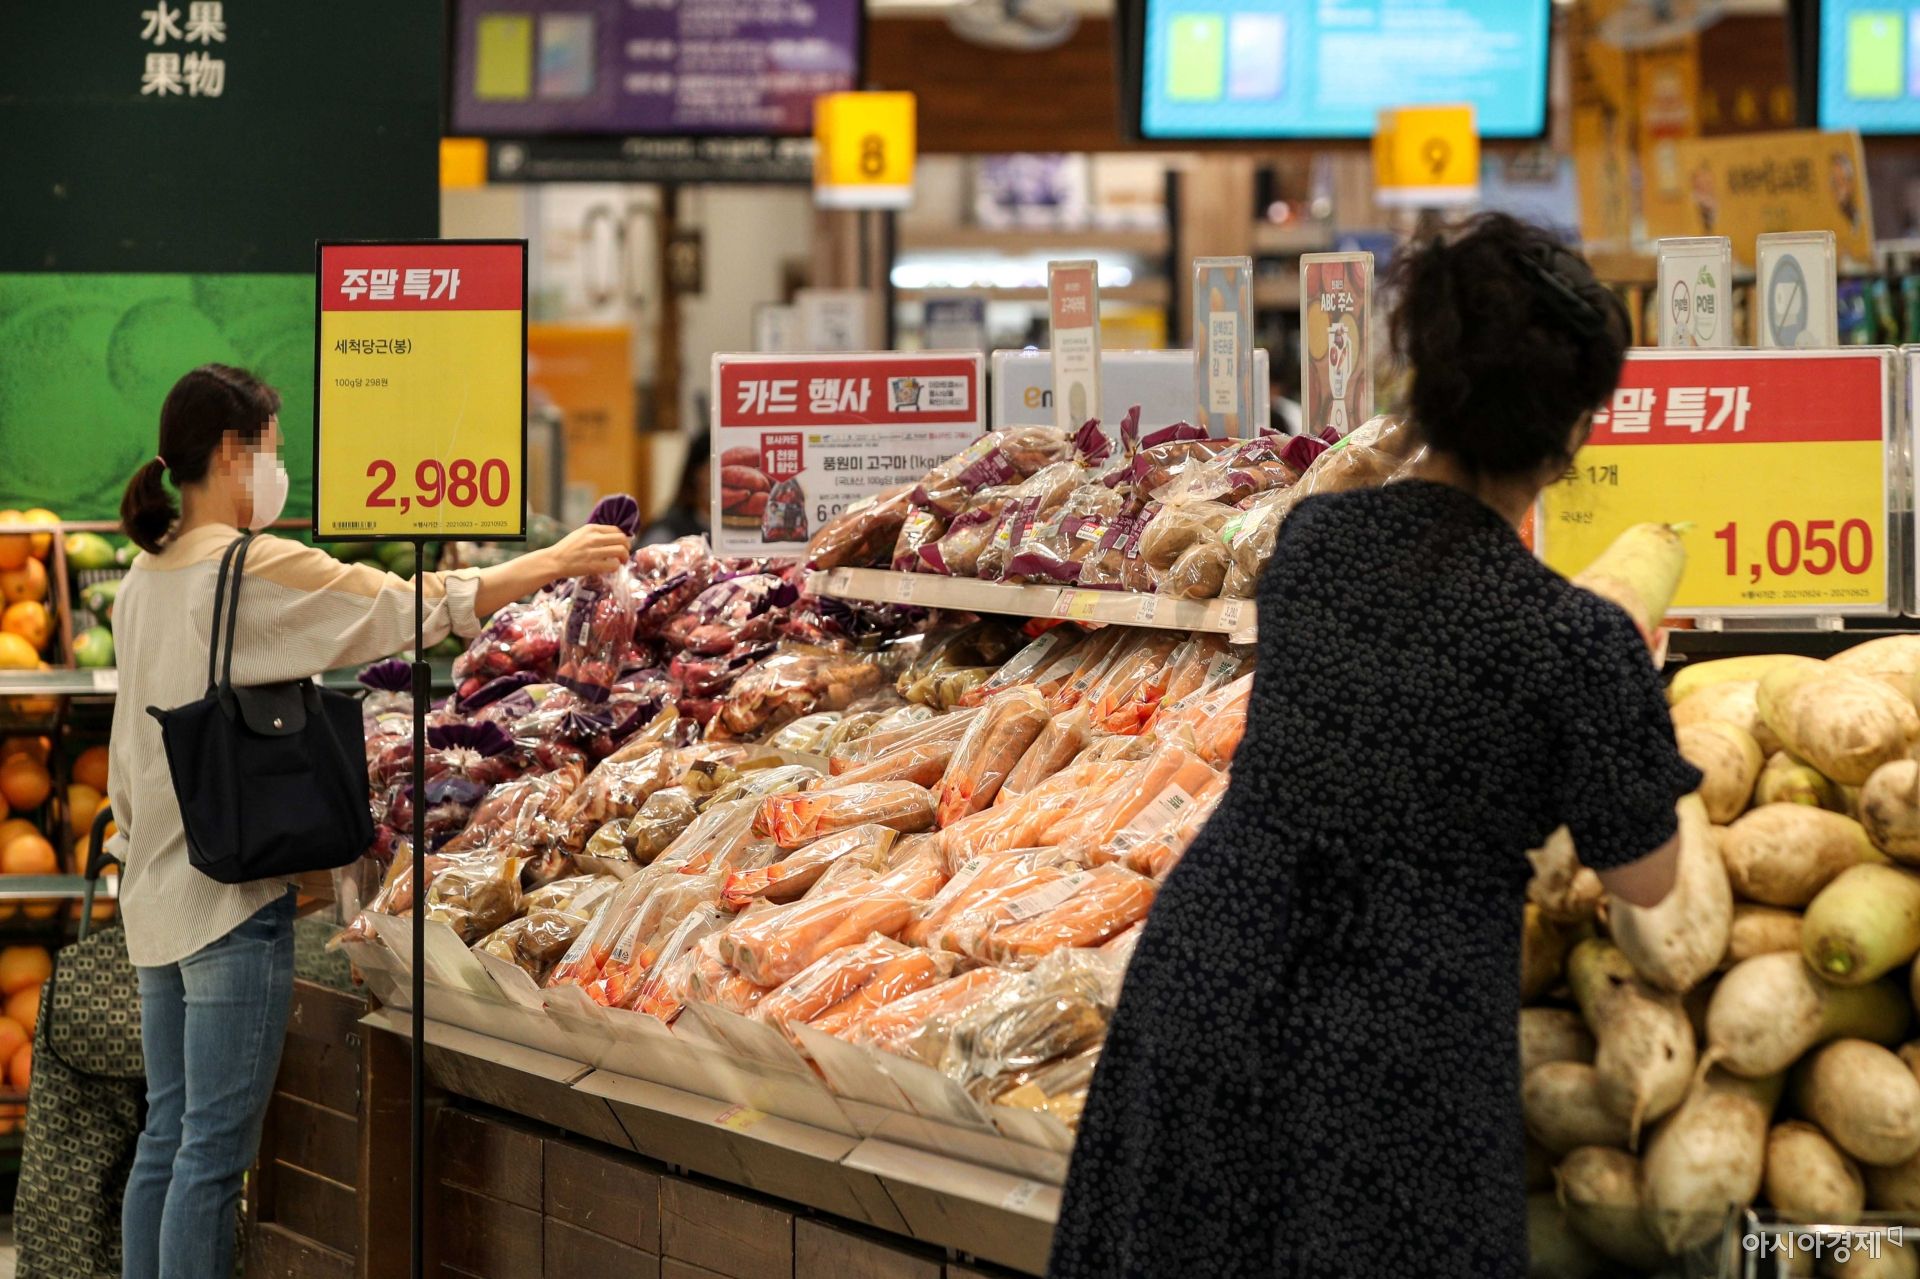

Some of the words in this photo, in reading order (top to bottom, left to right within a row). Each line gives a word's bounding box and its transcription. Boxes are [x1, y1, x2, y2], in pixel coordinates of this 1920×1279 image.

[141, 0, 226, 45] 水果
[141, 51, 225, 97] 果物
[860, 133, 888, 179] 8
[341, 268, 399, 301] 주말
[403, 268, 460, 301] 특가
[1321, 294, 1337, 312] ABC
[1338, 292, 1354, 313] 주스
[335, 338, 412, 354] 세척당근(봉)
[335, 378, 362, 388] 100g당
[365, 378, 389, 387] 298원
[737, 379, 799, 415] 카드
[808, 378, 872, 413] 행사
[1664, 385, 1751, 433] 특가
[765, 451, 775, 474] 1
[823, 456, 863, 471] 풍원미
[867, 455, 906, 470] 고구마
[1587, 464, 1618, 486] 1개
[365, 458, 510, 515] 2,980
[1714, 518, 1873, 584] 1,050
